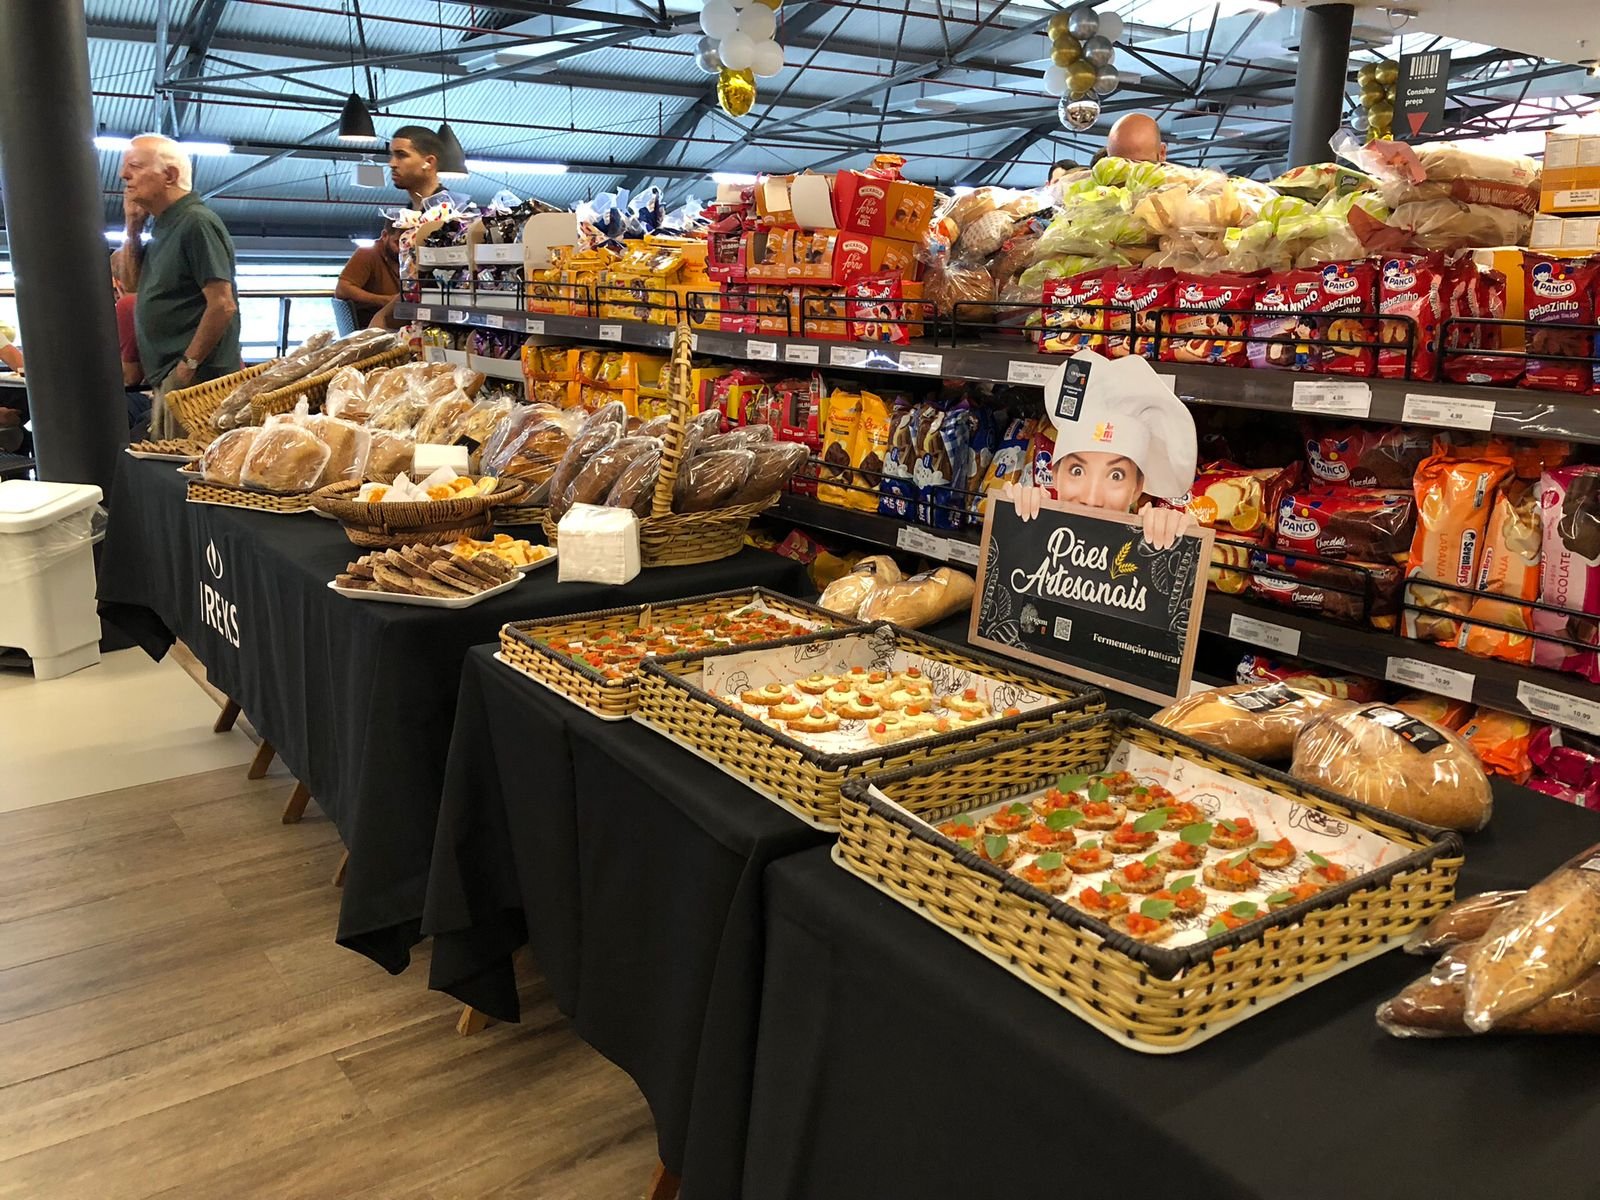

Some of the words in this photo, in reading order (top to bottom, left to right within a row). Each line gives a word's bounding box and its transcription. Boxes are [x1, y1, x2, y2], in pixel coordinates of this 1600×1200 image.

[1406, 87, 1436, 96] Consultar
[1405, 98, 1424, 107] preço
[1329, 281, 1355, 290] PANCO
[1388, 277, 1414, 285] PANCO
[1539, 283, 1572, 293] PANCO
[1315, 462, 1346, 474] PANCO
[1349, 476, 1377, 488] Chocolate
[1282, 521, 1316, 533] PANCO
[1047, 527, 1109, 571] Pães
[1315, 536, 1346, 550] Chocolate
[1437, 533, 1449, 578] LARANJA
[1010, 556, 1148, 612] Artesanais
[1291, 592, 1325, 603] Chocolate
[199, 580, 241, 649] IREKS
[1093, 632, 1147, 655] Fermentação
[1147, 649, 1181, 665] natural
[1573, 710, 1591, 720] 10.99
